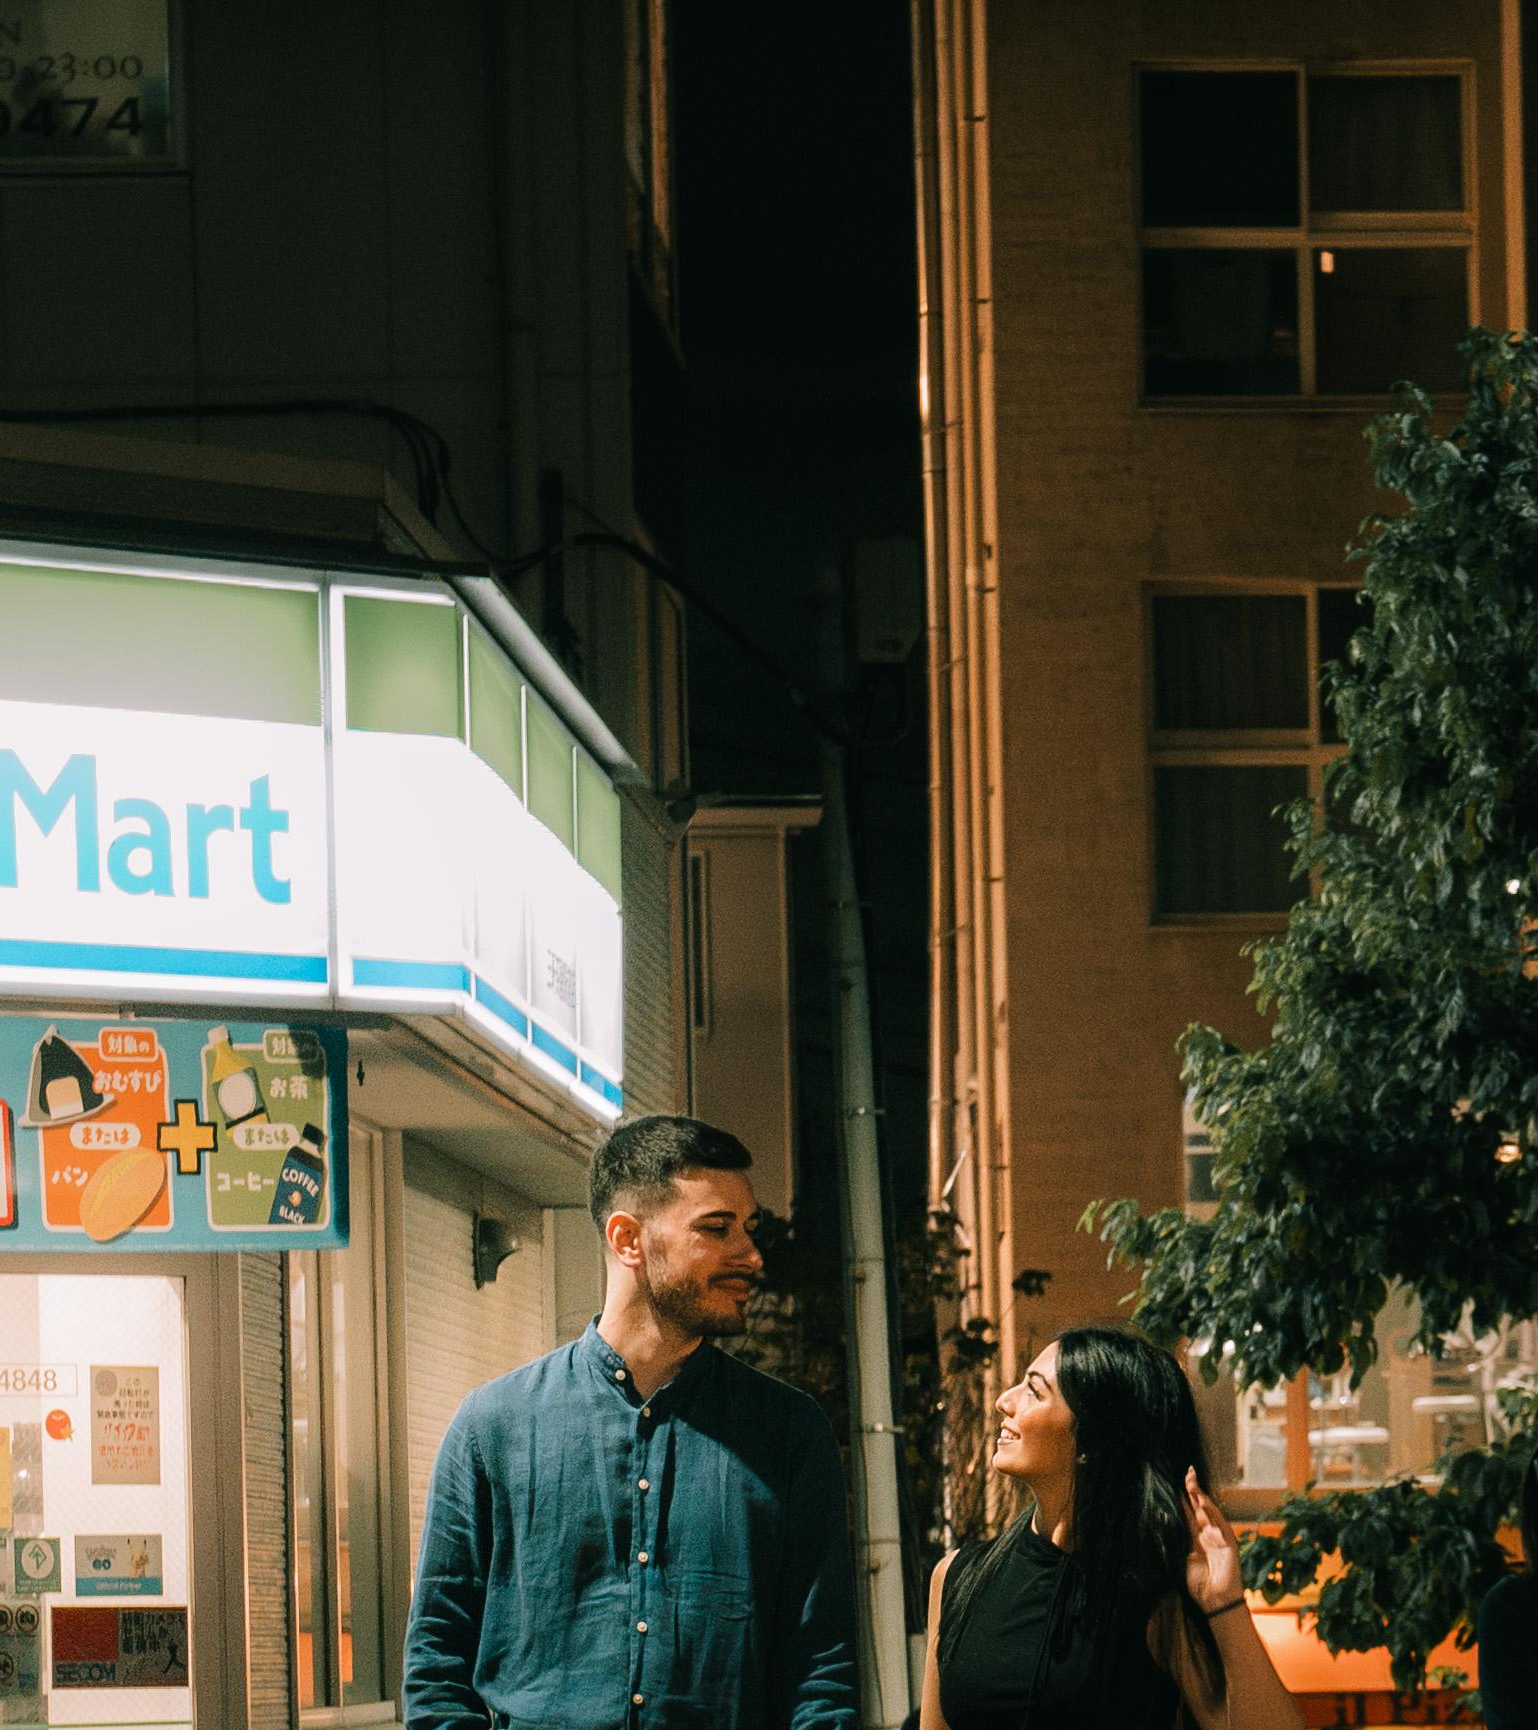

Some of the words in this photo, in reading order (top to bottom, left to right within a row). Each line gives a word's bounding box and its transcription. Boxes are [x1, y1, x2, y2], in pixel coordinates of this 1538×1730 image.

[93, 1069, 162, 1093] おむすび
[269, 1076, 309, 1099] お茶
[81, 1126, 131, 1144] または
[243, 1127, 290, 1144] または
[51, 1165, 89, 1187] パン
[216, 1171, 275, 1192] コーヒー
[281, 1167, 320, 1198] COFFEE
[278, 1205, 306, 1224] BLACK
[55, 1662, 116, 1683] SECOM
